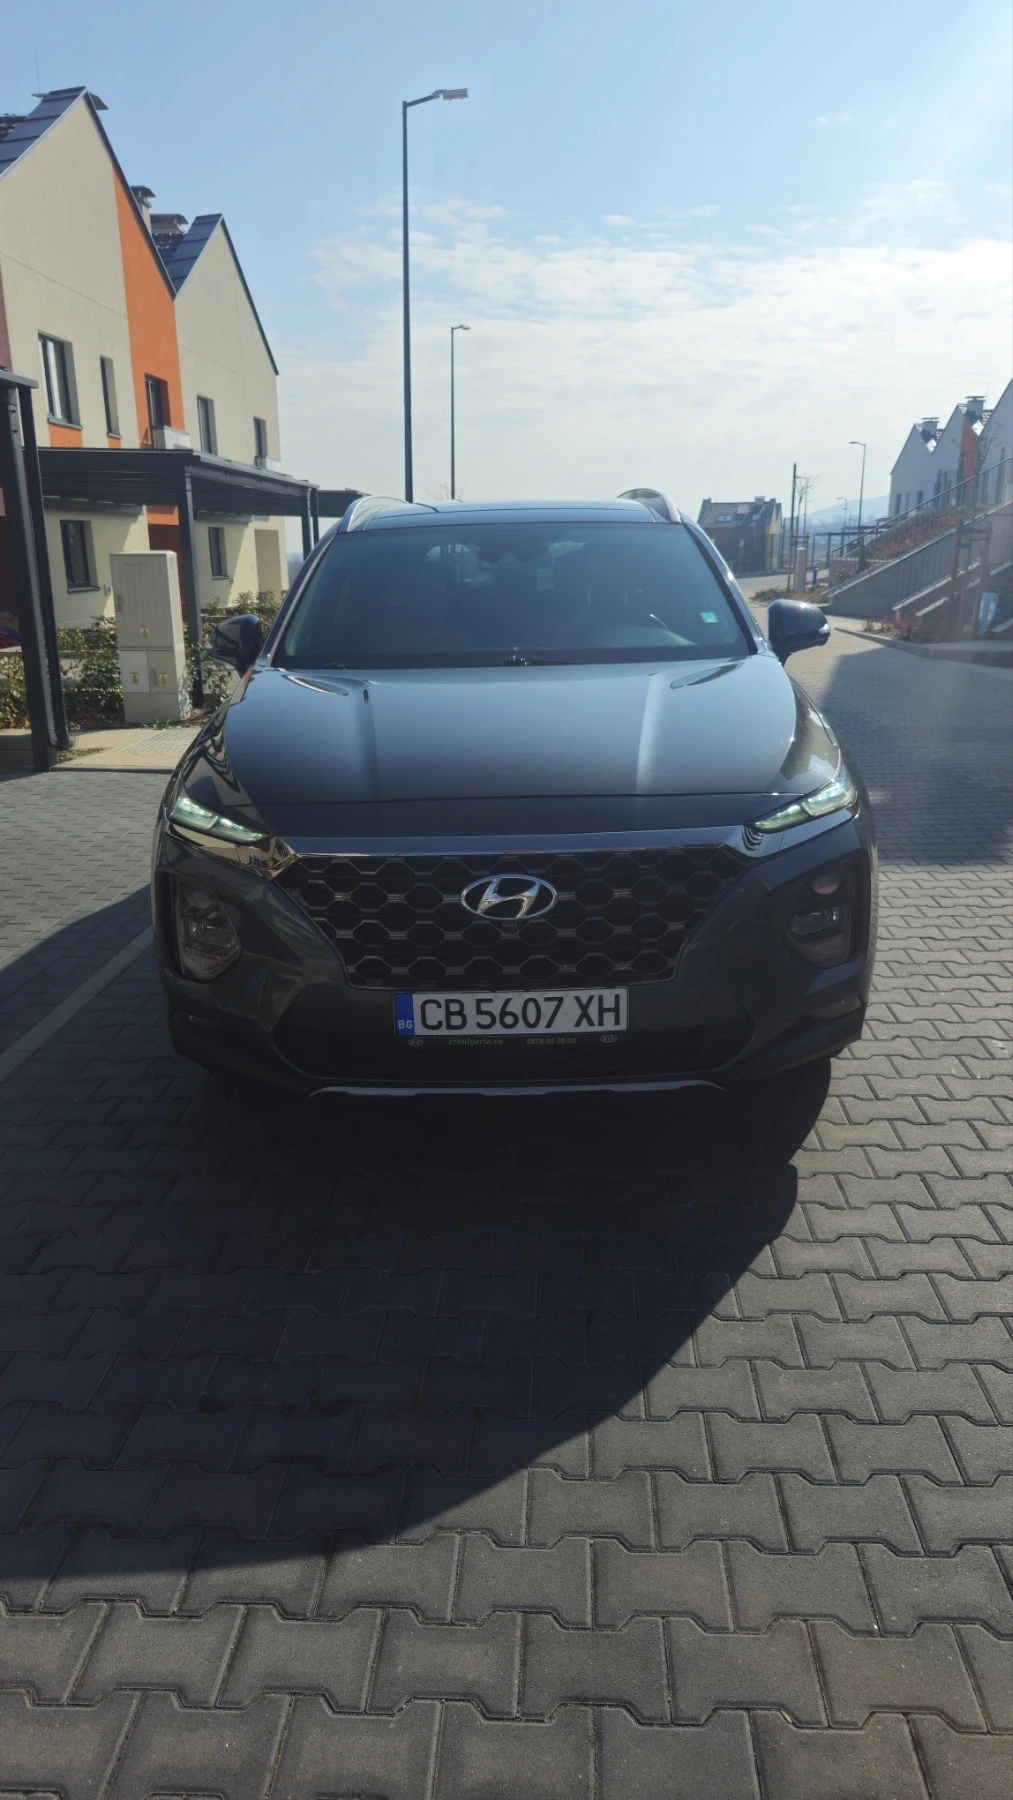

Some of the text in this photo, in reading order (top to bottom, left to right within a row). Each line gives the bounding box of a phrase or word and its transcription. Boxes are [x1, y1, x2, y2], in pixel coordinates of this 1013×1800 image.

[420, 993, 621, 1030] CB 5607 XH
[397, 1019, 413, 1030] BG
